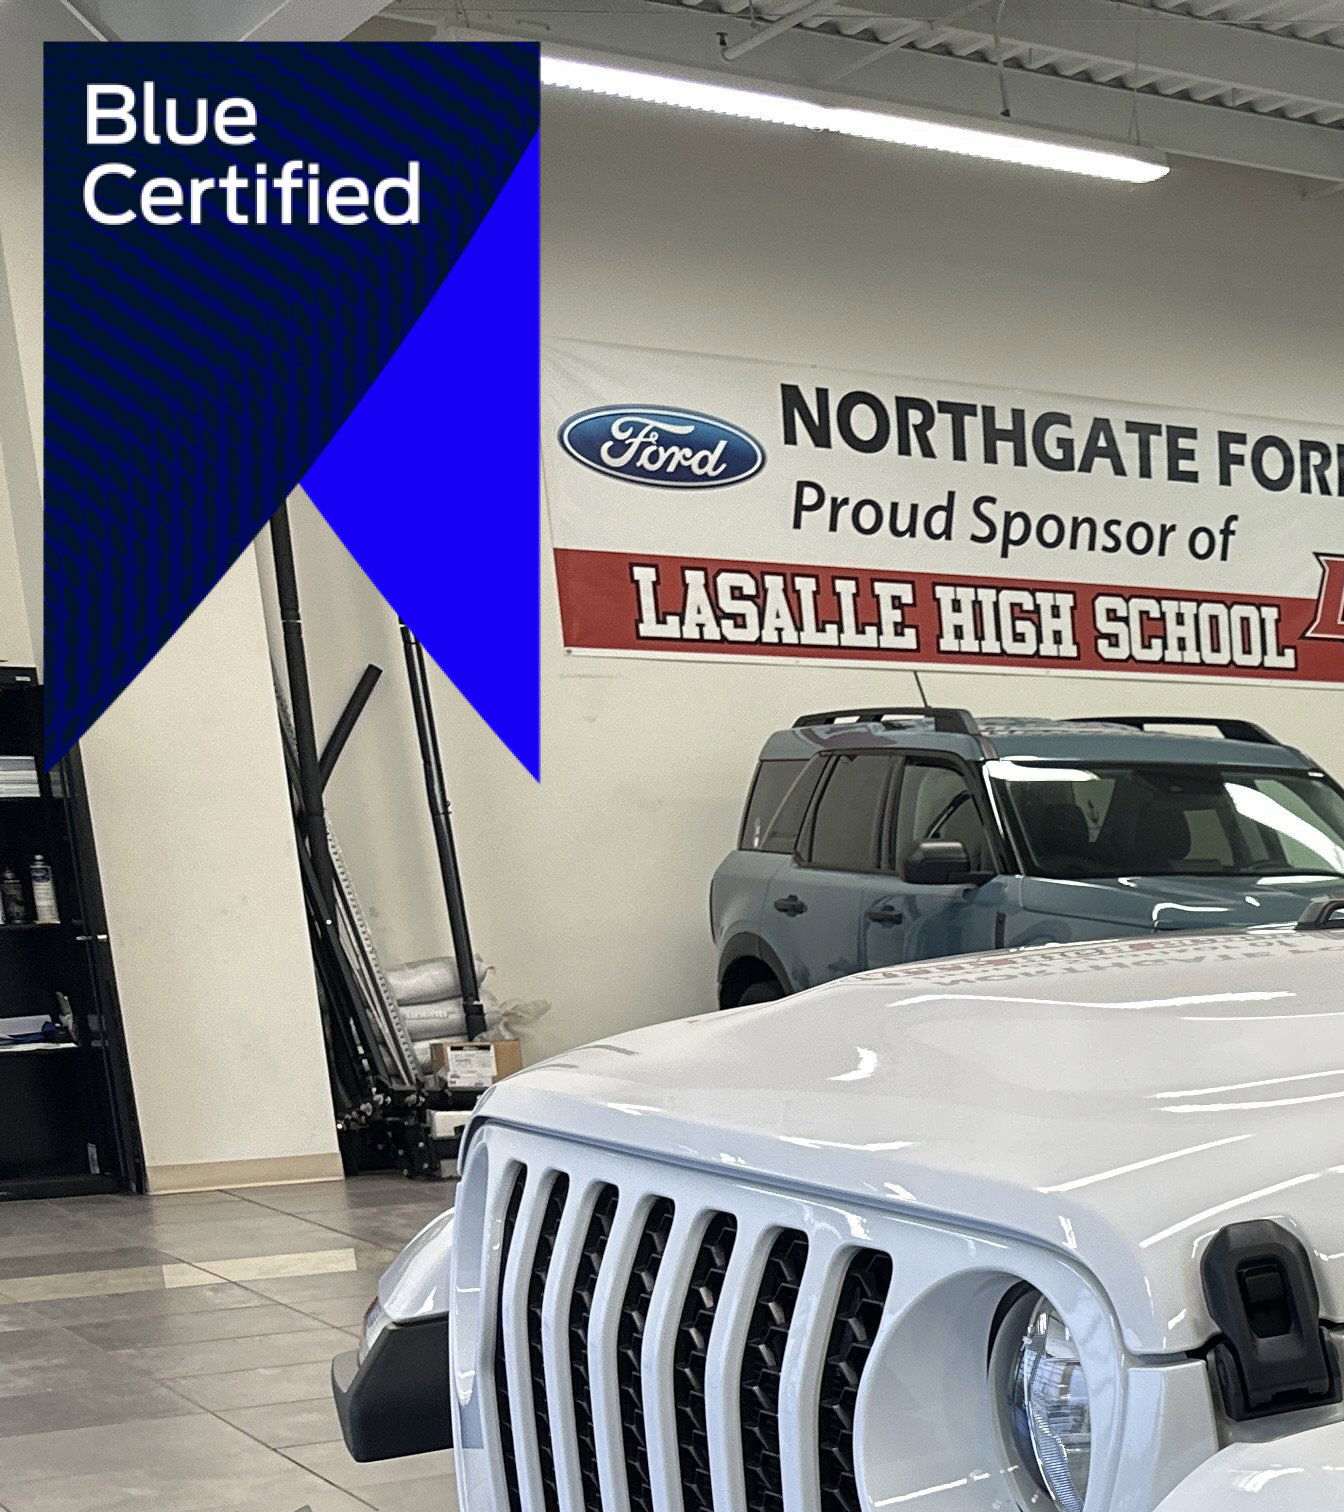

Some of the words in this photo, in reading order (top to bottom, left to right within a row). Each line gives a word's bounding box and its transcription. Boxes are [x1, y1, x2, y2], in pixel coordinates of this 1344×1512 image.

[599, 417, 726, 479] Ford
[780, 384, 1199, 484] NORTHGATE
[791, 480, 955, 542] Proud
[969, 495, 1176, 561] Sponsor
[1187, 513, 1238, 562] of
[629, 563, 918, 653] LASALLE
[932, 583, 1079, 660] HIGH
[1094, 595, 1297, 671] SCHOOL
